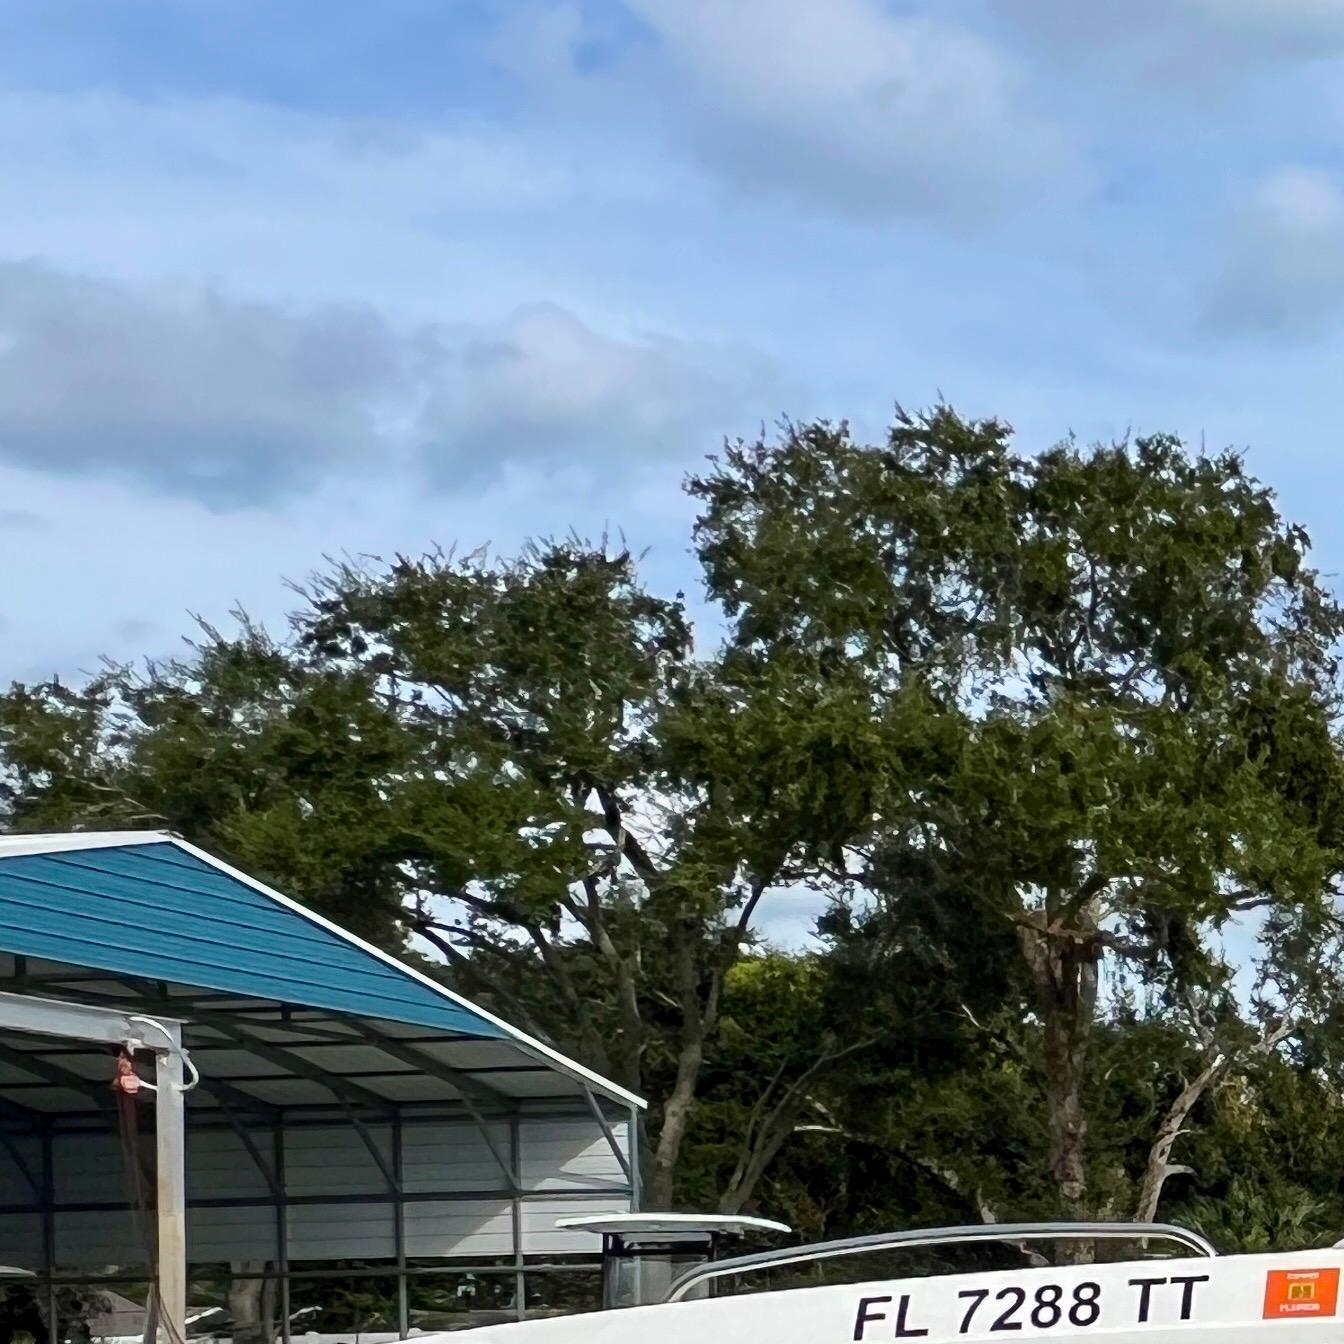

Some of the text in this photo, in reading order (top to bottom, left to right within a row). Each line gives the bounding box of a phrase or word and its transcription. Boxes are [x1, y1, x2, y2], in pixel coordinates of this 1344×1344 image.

[853, 1275, 1210, 1341] FL 7288 TT
